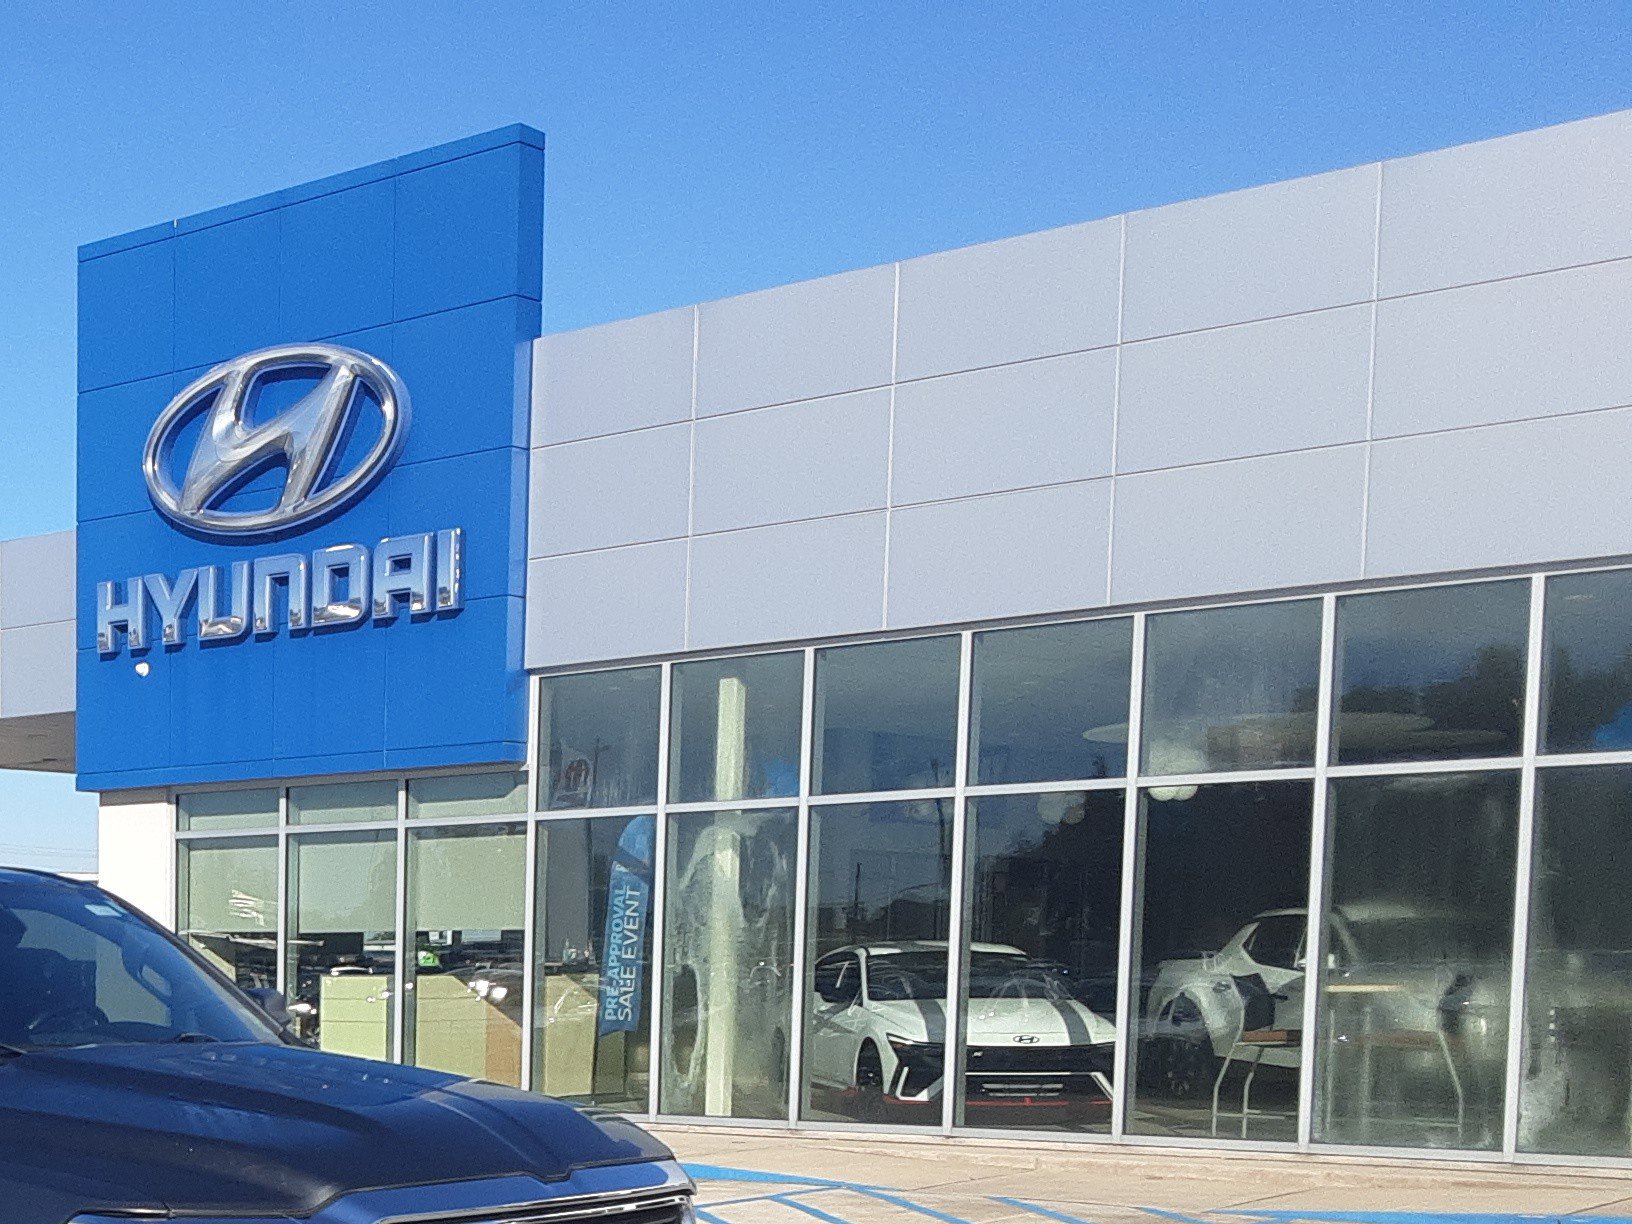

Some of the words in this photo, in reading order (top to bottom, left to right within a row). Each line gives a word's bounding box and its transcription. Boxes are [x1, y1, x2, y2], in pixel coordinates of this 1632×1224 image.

[96, 528, 463, 654] HYUNDAI
[605, 885, 626, 1020] PRE-APPROVAL
[621, 885, 641, 960] EVENT
[618, 966, 637, 1021] SALE
